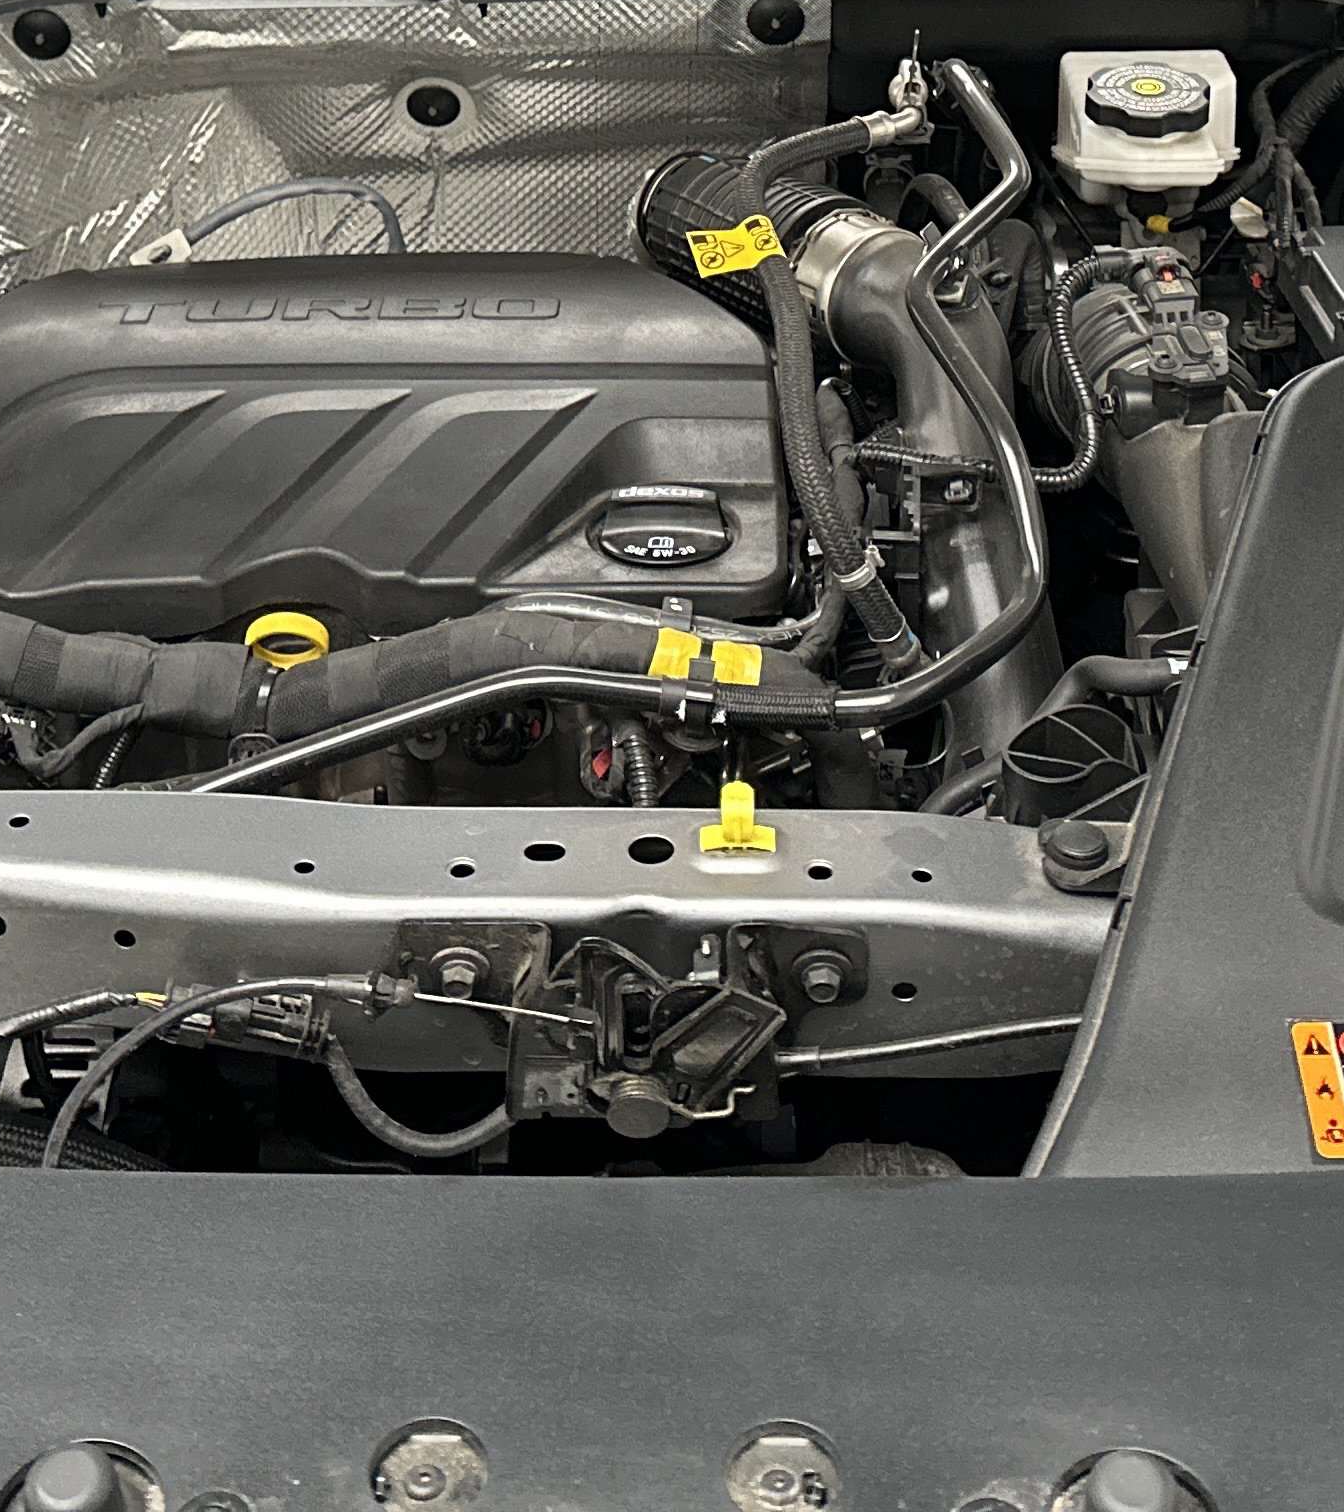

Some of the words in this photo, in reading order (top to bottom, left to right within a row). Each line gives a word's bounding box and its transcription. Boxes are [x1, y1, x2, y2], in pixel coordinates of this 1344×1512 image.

[98, 296, 561, 326] TURBO
[618, 486, 705, 499] dexos
[623, 544, 649, 557] SAE
